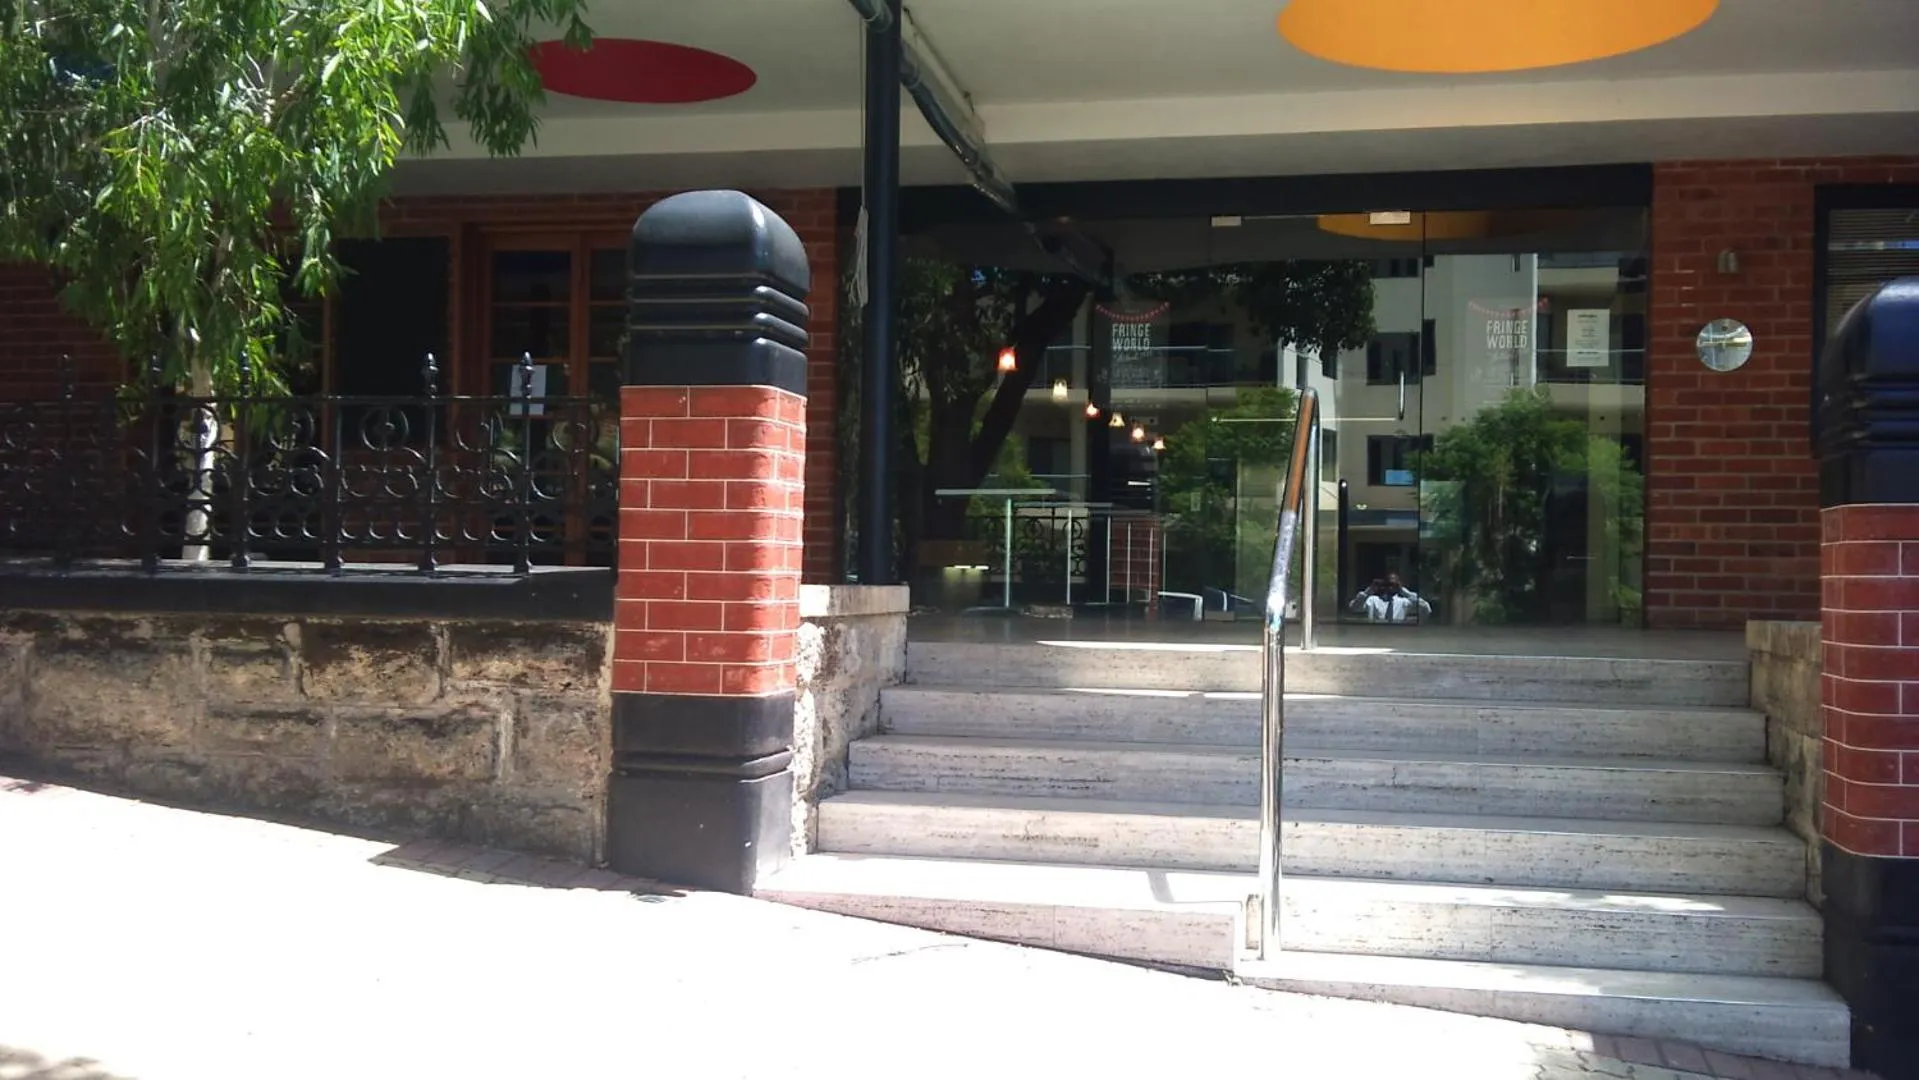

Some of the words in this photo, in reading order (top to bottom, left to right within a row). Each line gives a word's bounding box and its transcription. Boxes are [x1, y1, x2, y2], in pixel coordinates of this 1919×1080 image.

[1112, 323, 1152, 337] FRINGE
[1486, 320, 1528, 334] FRINGE
[1112, 338, 1150, 350] WORLD
[1486, 335, 1528, 349] WORLD
